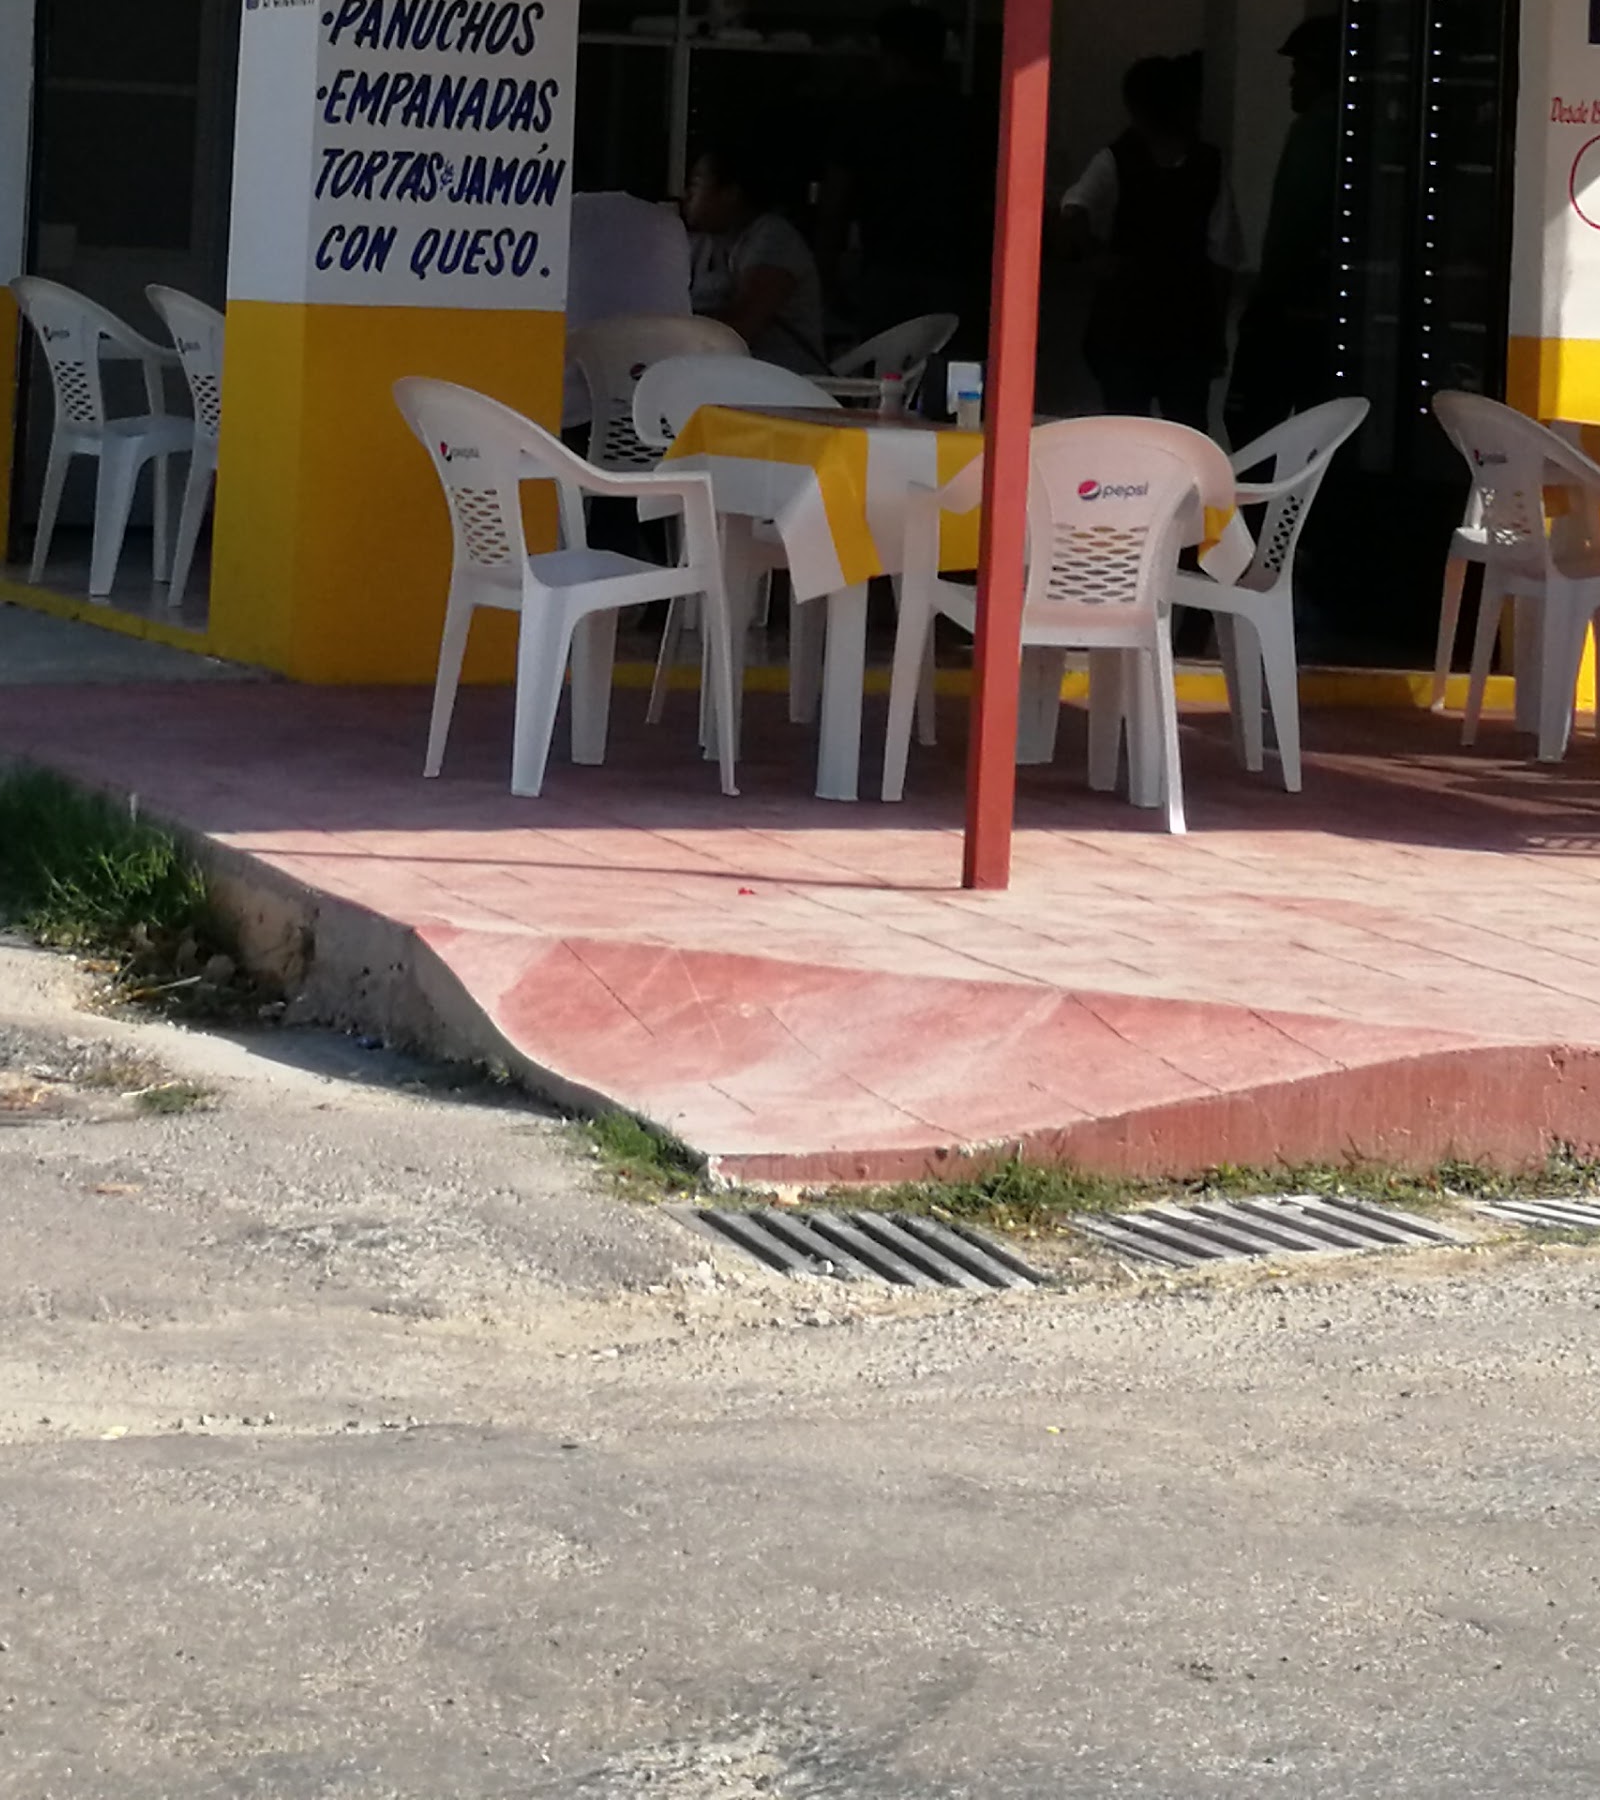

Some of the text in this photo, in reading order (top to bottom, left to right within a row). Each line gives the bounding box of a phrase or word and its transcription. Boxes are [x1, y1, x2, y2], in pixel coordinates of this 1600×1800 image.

[324, 70, 560, 134] EMPANADAS
[314, 148, 442, 203] TORTAS
[447, 142, 567, 207] JAMÓN
[314, 225, 398, 273] CON
[1101, 481, 1149, 500] pepsi
